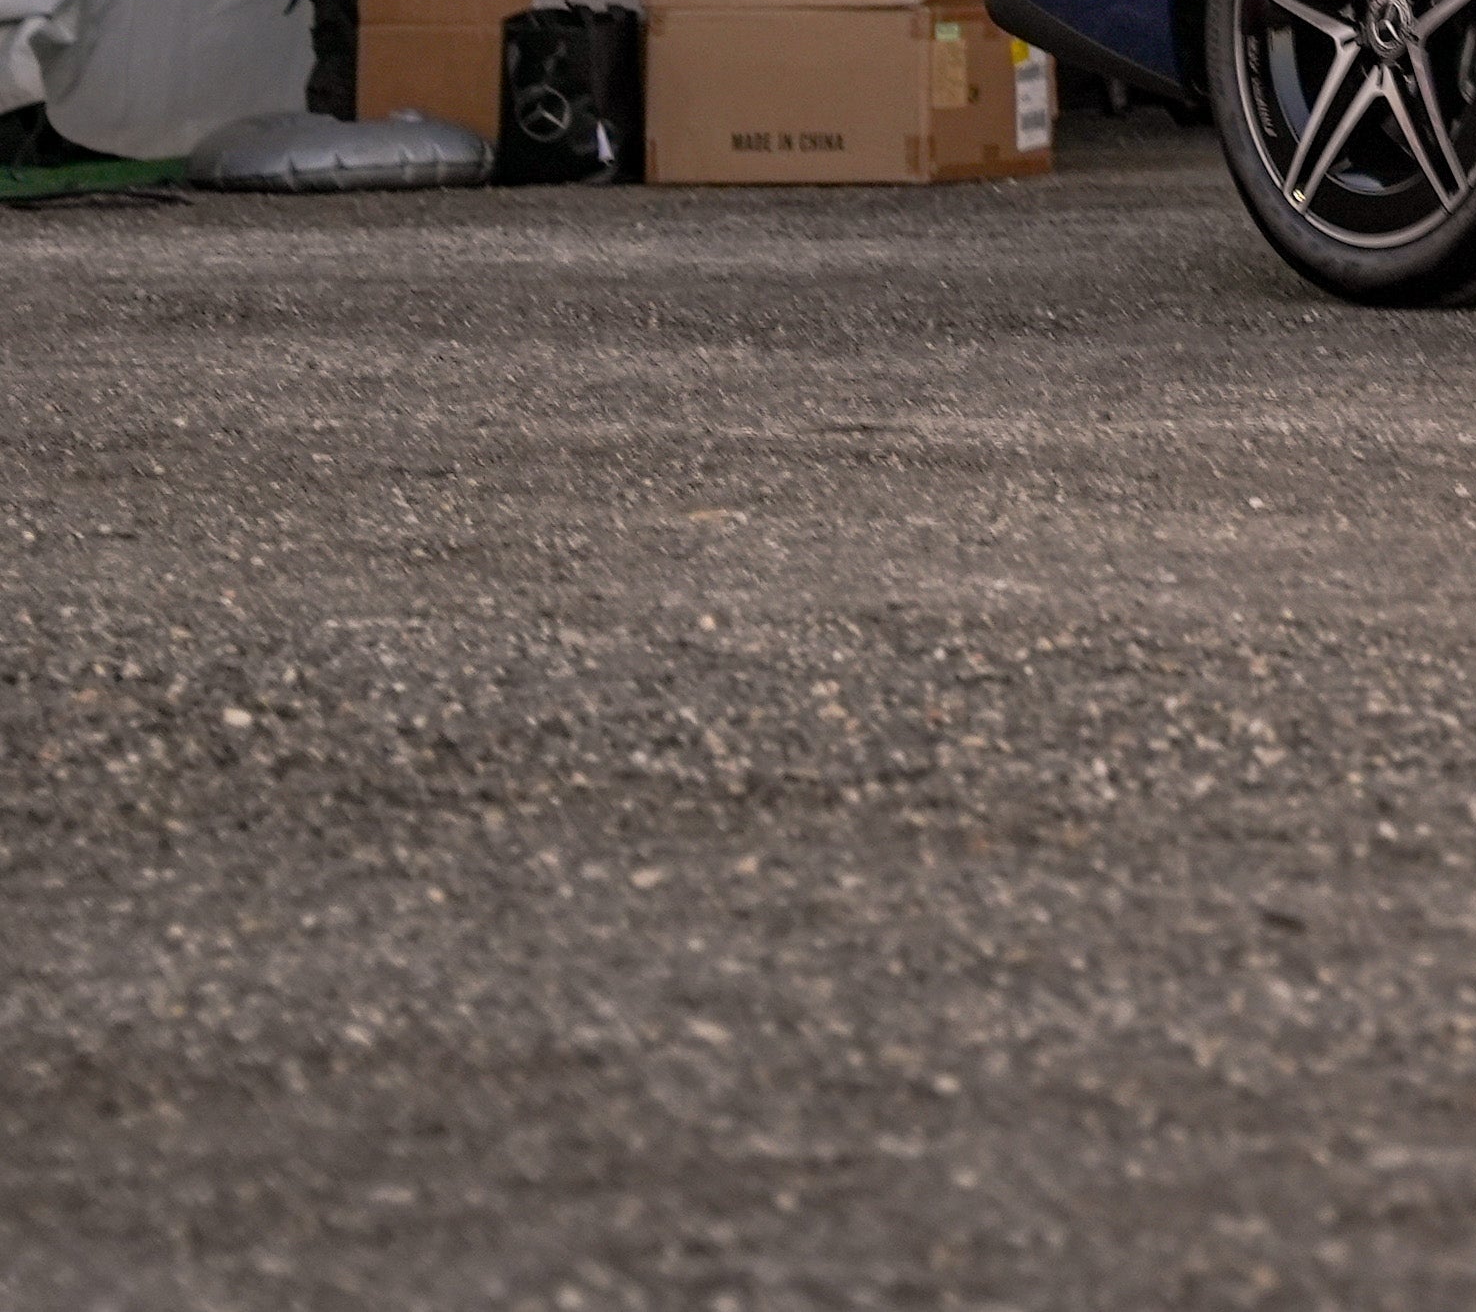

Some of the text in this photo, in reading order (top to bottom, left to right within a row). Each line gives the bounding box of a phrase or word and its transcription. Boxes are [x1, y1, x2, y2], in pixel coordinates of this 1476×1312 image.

[731, 133, 845, 153] MADE IN CHINA
